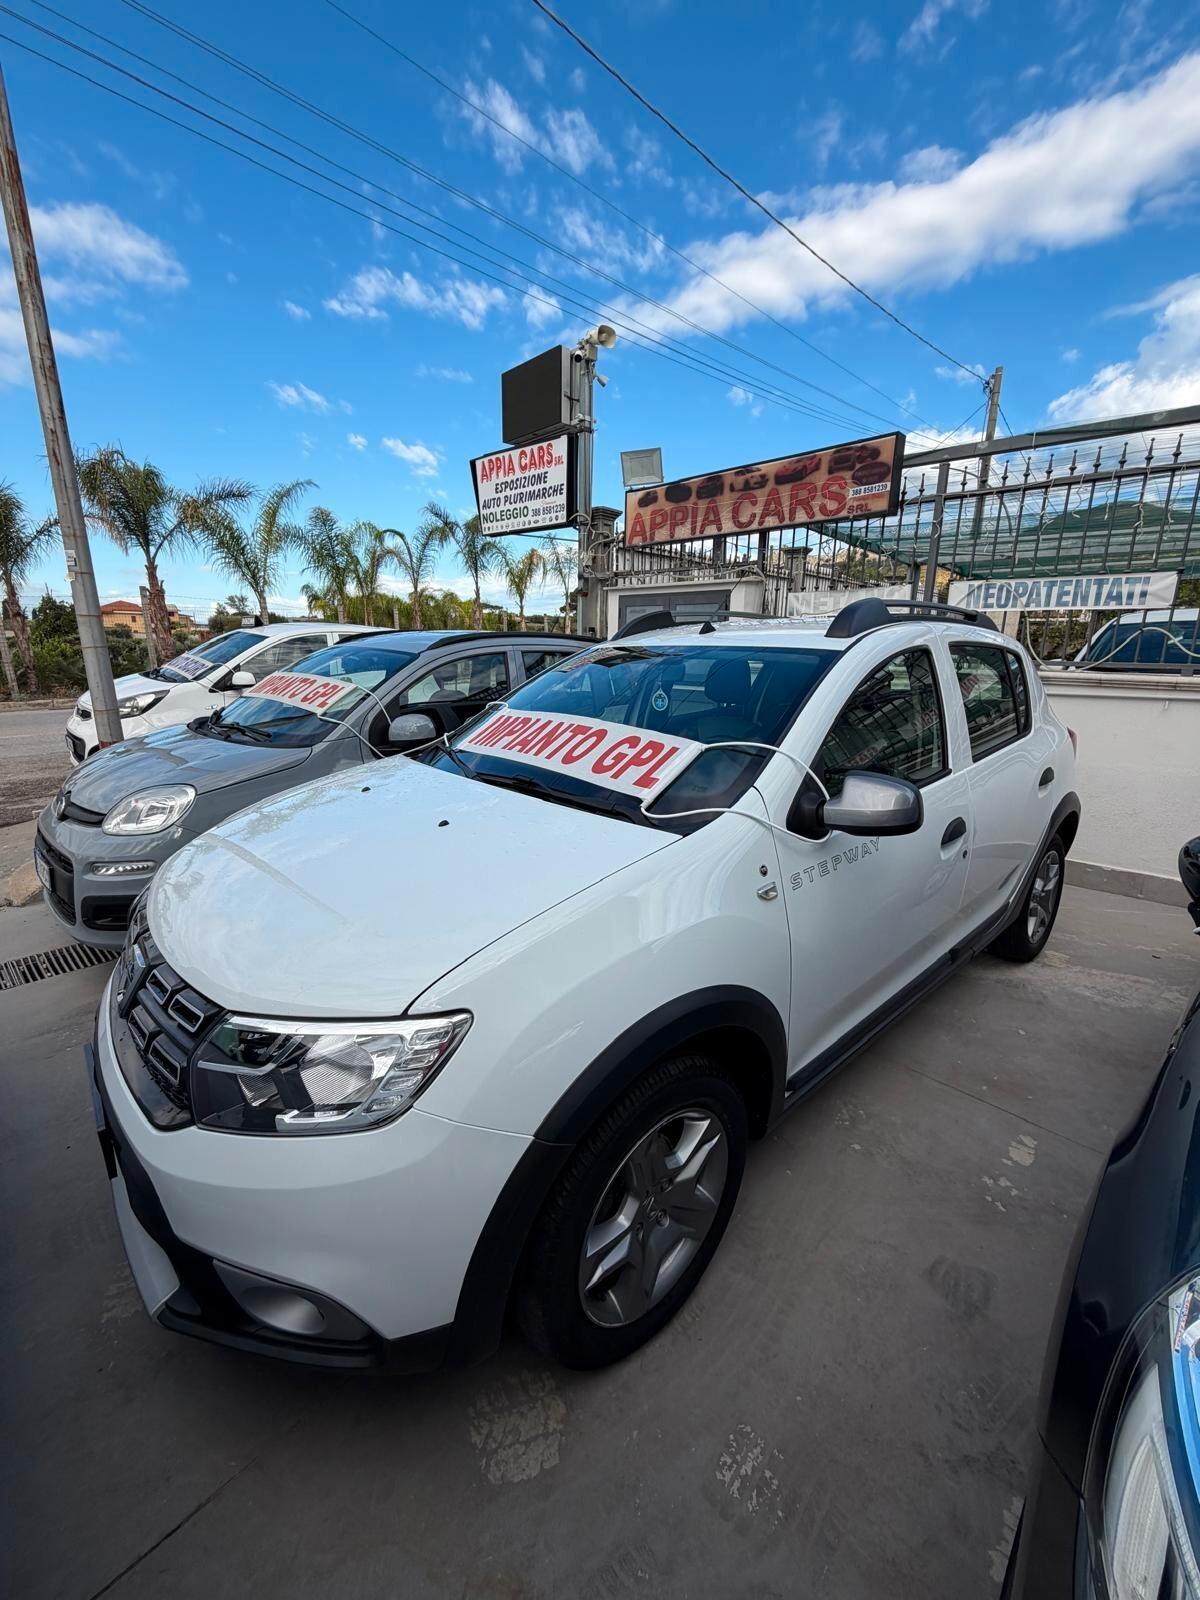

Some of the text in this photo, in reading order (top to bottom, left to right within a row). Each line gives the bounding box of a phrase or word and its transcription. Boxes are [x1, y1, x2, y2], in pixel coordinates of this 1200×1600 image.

[480, 442, 564, 483] APPIA CARS SRL
[482, 483, 564, 510] AUTO PLURIMARCHE
[495, 471, 549, 494] ESPOSIZIONE
[851, 488, 862, 496] 388
[482, 506, 529, 524] NOLEGGIO
[531, 508, 541, 517] 388
[628, 475, 872, 544] APPIA CARS SRL
[965, 576, 1152, 608] NEOPATENTATI
[300, 682, 346, 708] GPL
[468, 714, 680, 789] IMPIANTO GPL
[790, 836, 880, 891] STEPWAY
